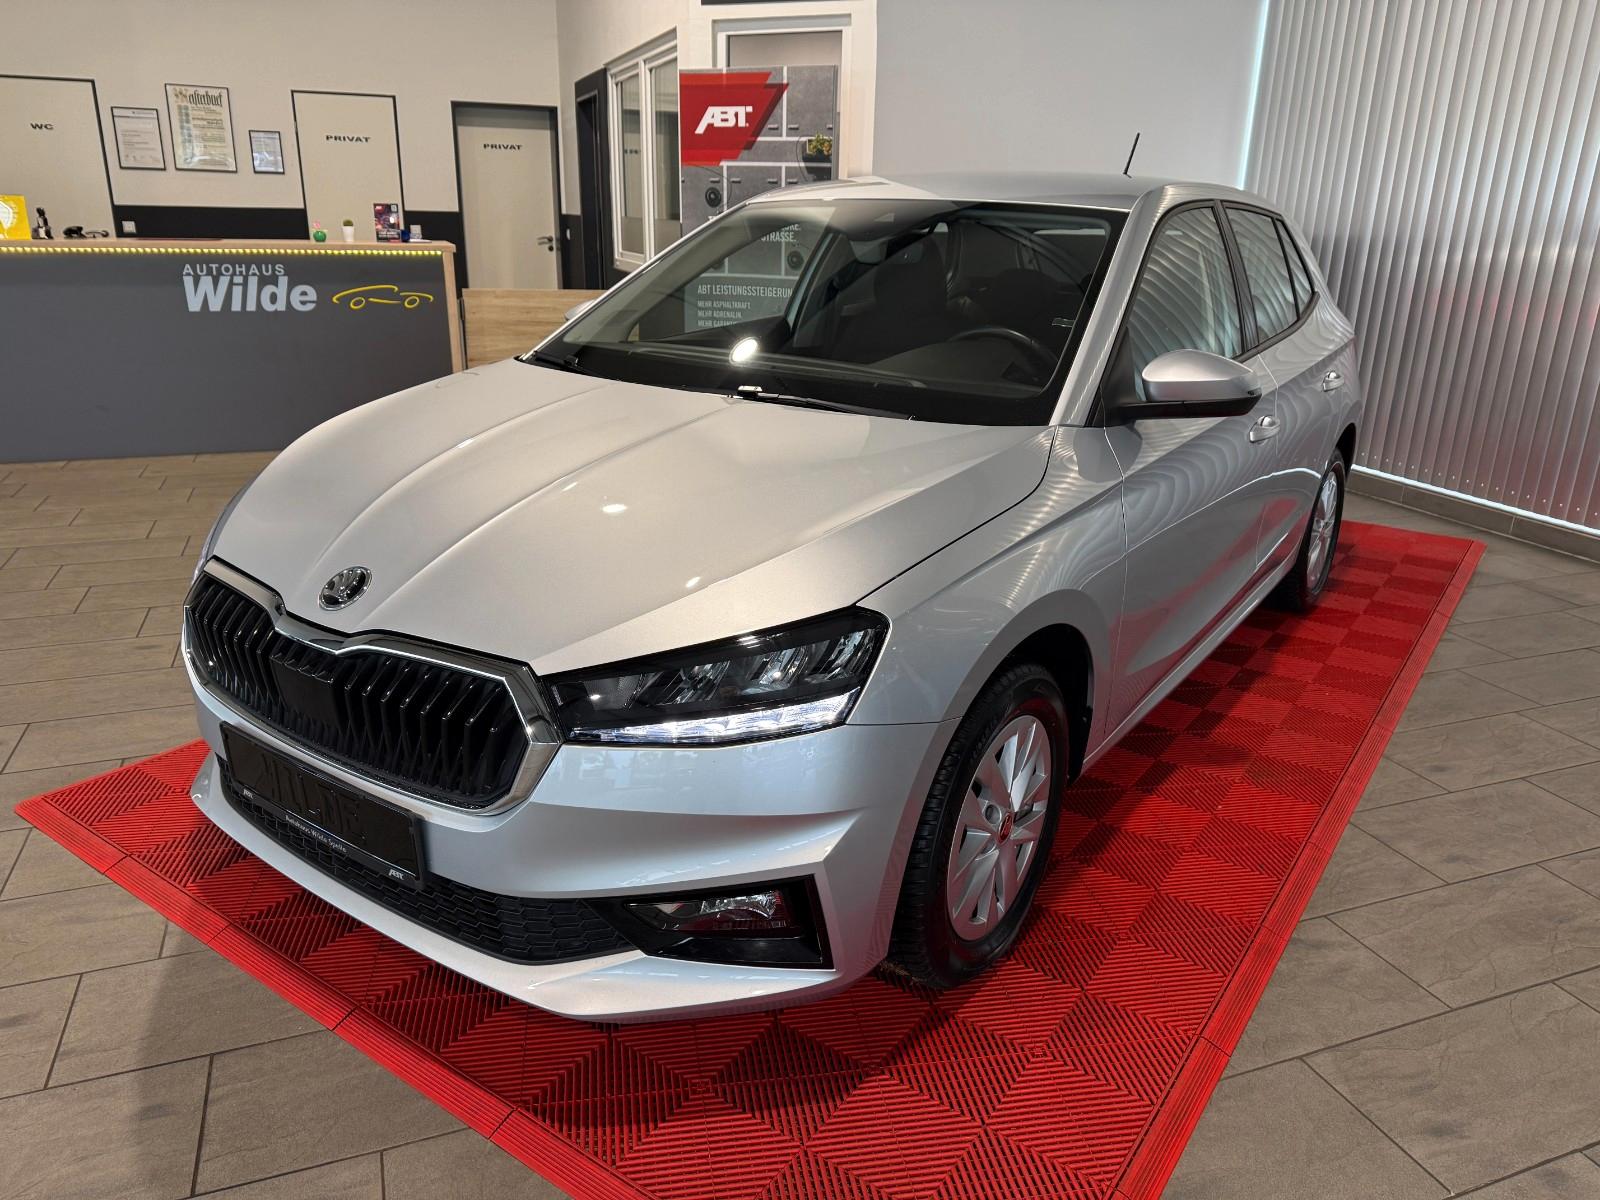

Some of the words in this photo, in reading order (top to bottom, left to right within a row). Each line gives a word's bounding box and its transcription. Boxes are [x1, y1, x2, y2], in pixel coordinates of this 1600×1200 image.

[694, 105, 753, 135] ABT
[30, 122, 54, 131] WC
[325, 134, 372, 143] PRIVAT
[483, 143, 523, 151] PRIVAT
[183, 263, 286, 276] AUTOHAUS
[183, 275, 318, 312] Wilde
[697, 284, 711, 295] ABT
[697, 300, 712, 308] MEHR
